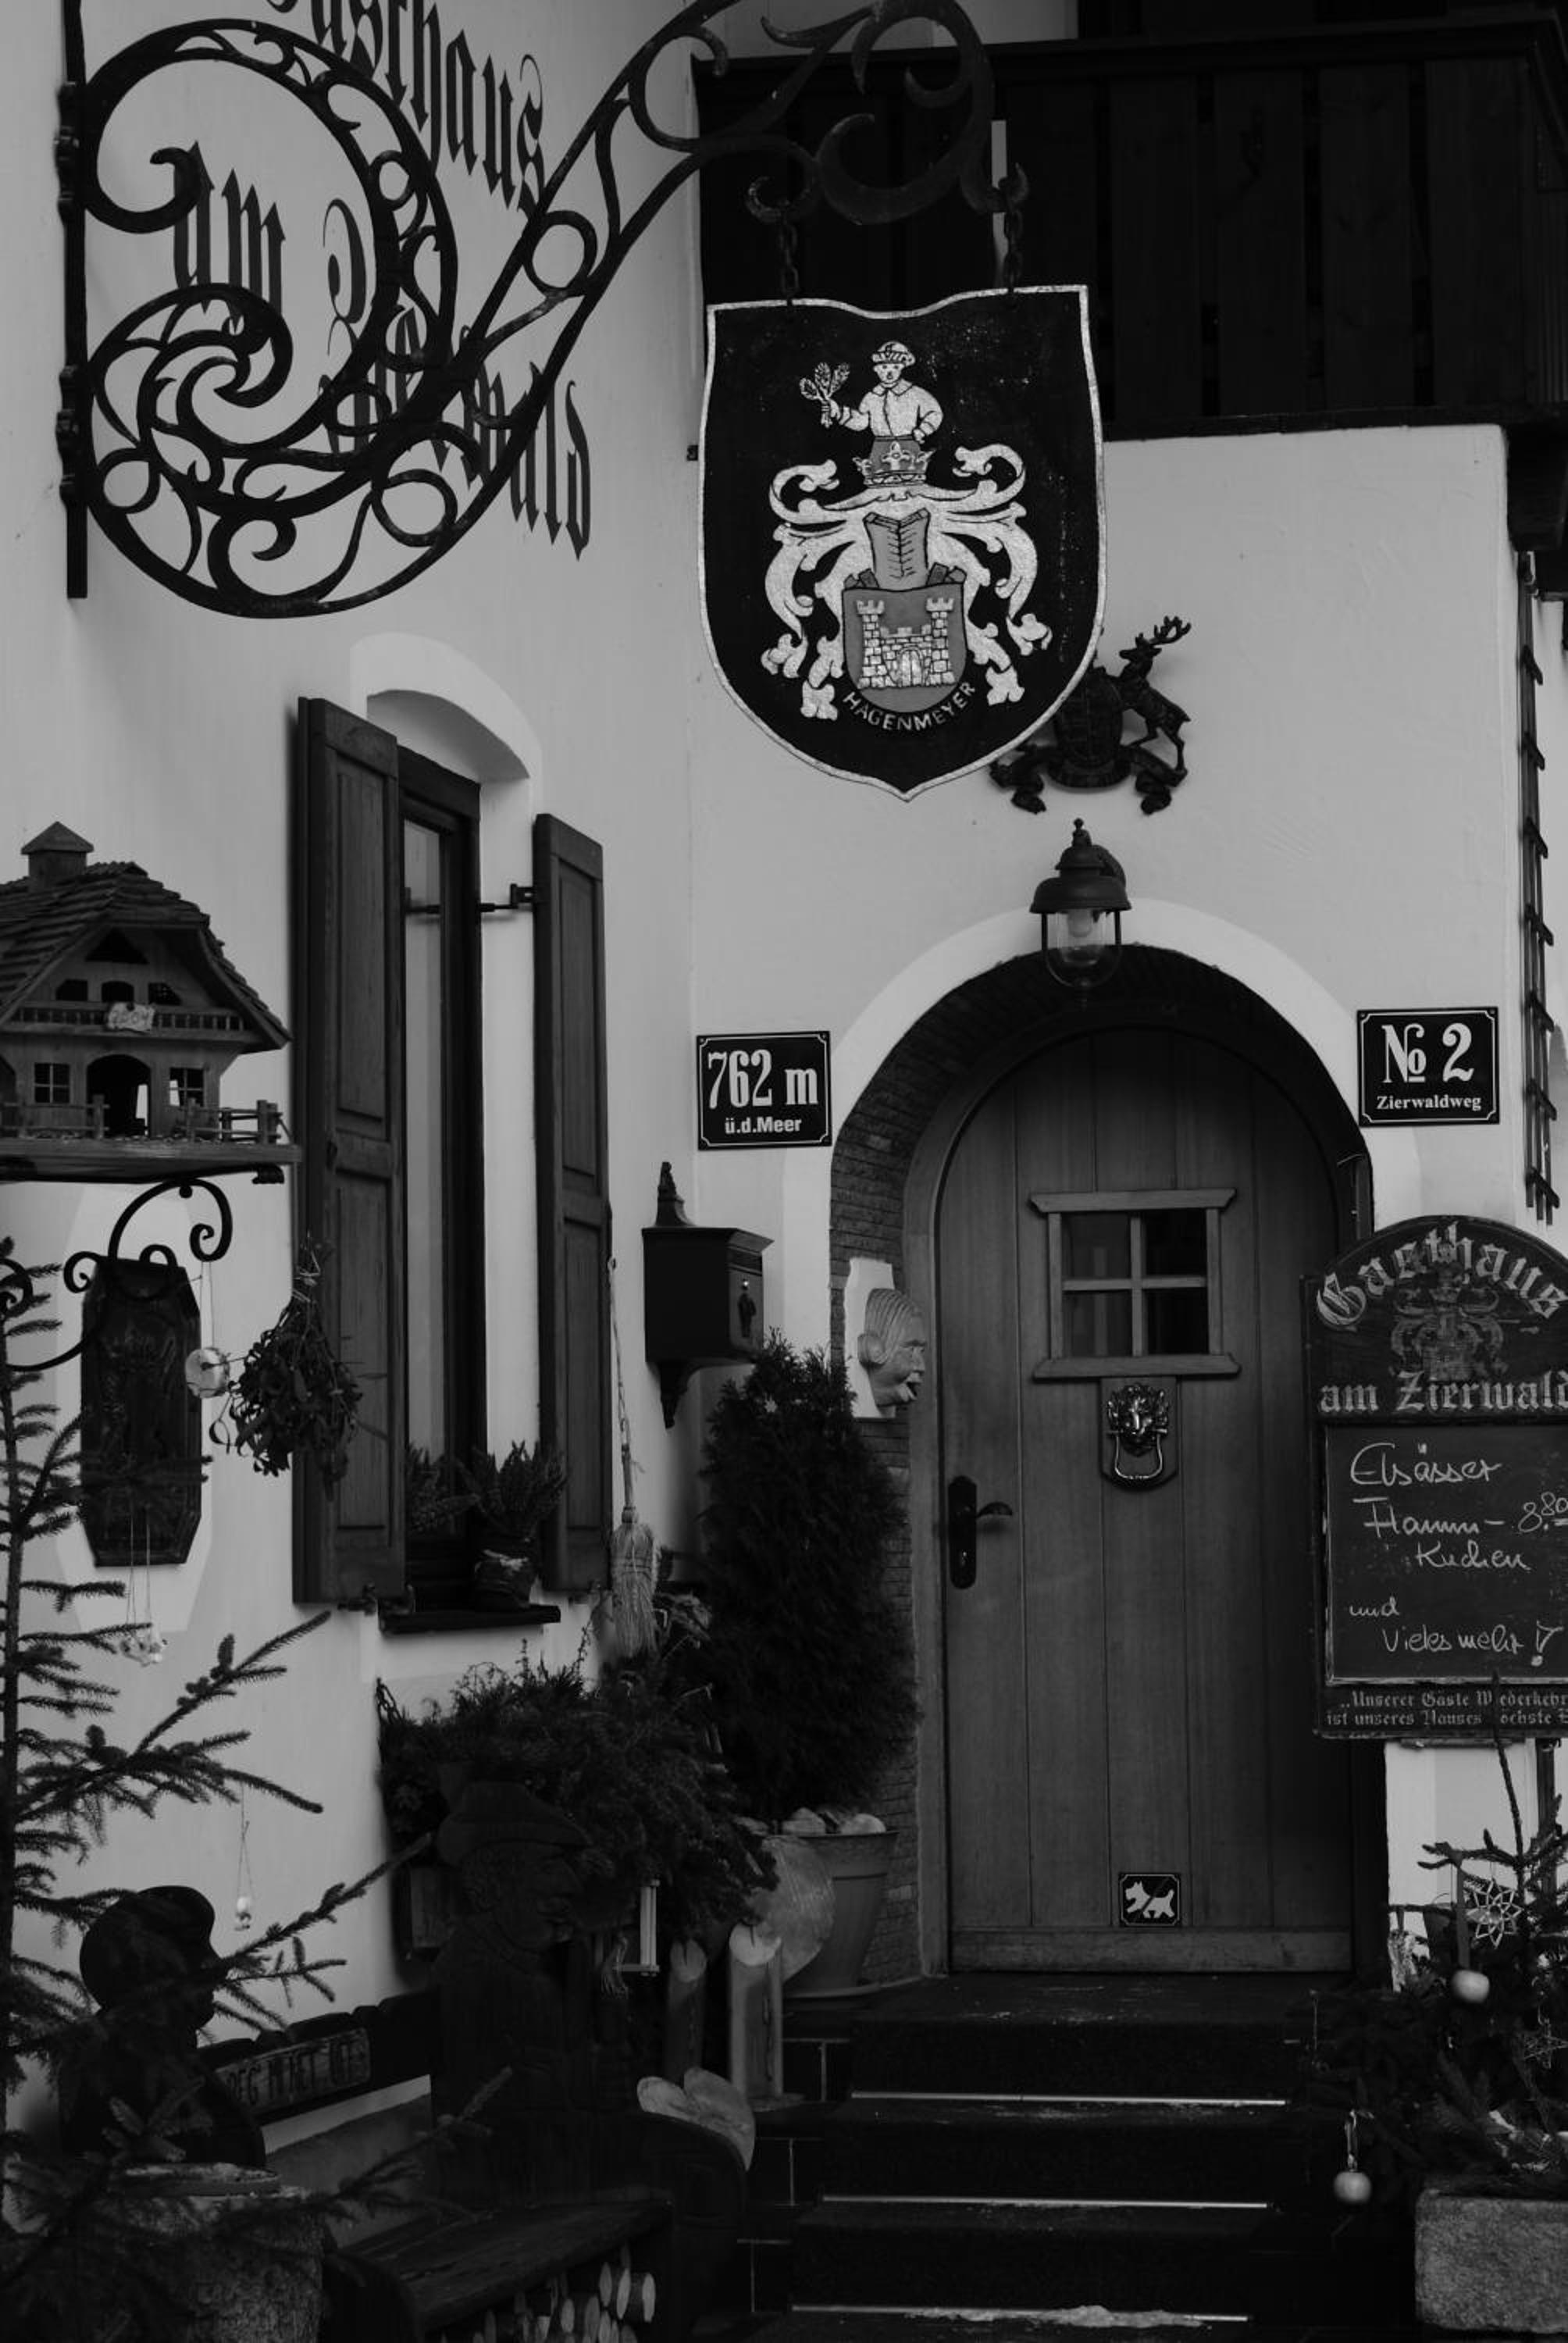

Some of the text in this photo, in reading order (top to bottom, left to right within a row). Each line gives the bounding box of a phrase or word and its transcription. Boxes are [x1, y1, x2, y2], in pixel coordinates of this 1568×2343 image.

[843, 681, 976, 731] HAGENMEYER
[1442, 1022, 1475, 1082] 2
[707, 1048, 819, 1110] 762 m
[1375, 1093, 1482, 1112] Zierwaldweg
[1316, 1221, 1568, 1325] Gasthaus
[1320, 1384, 1379, 1413] am
[1349, 1442, 1503, 1487] Elsässer
[1349, 1596, 1401, 1617] und
[1326, 1709, 1348, 1726] ist
